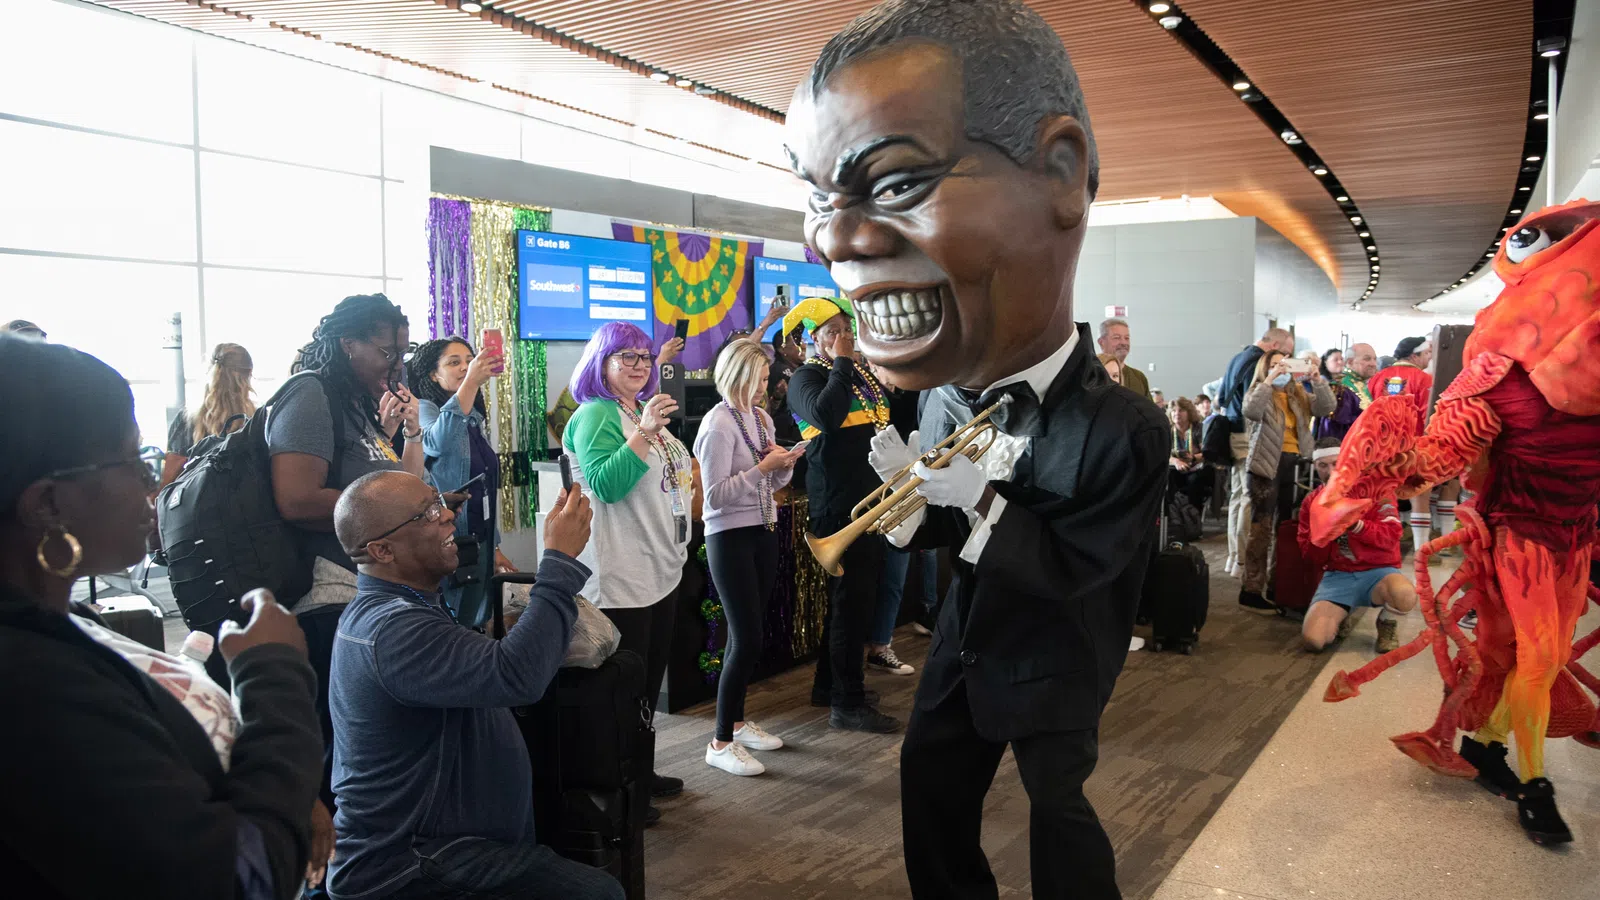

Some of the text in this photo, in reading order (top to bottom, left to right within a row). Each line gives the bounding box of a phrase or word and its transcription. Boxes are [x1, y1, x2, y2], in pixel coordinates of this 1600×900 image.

[538, 238, 570, 249] Gate B6
[766, 262, 779, 271] Gate
[530, 280, 575, 292] Southwest
